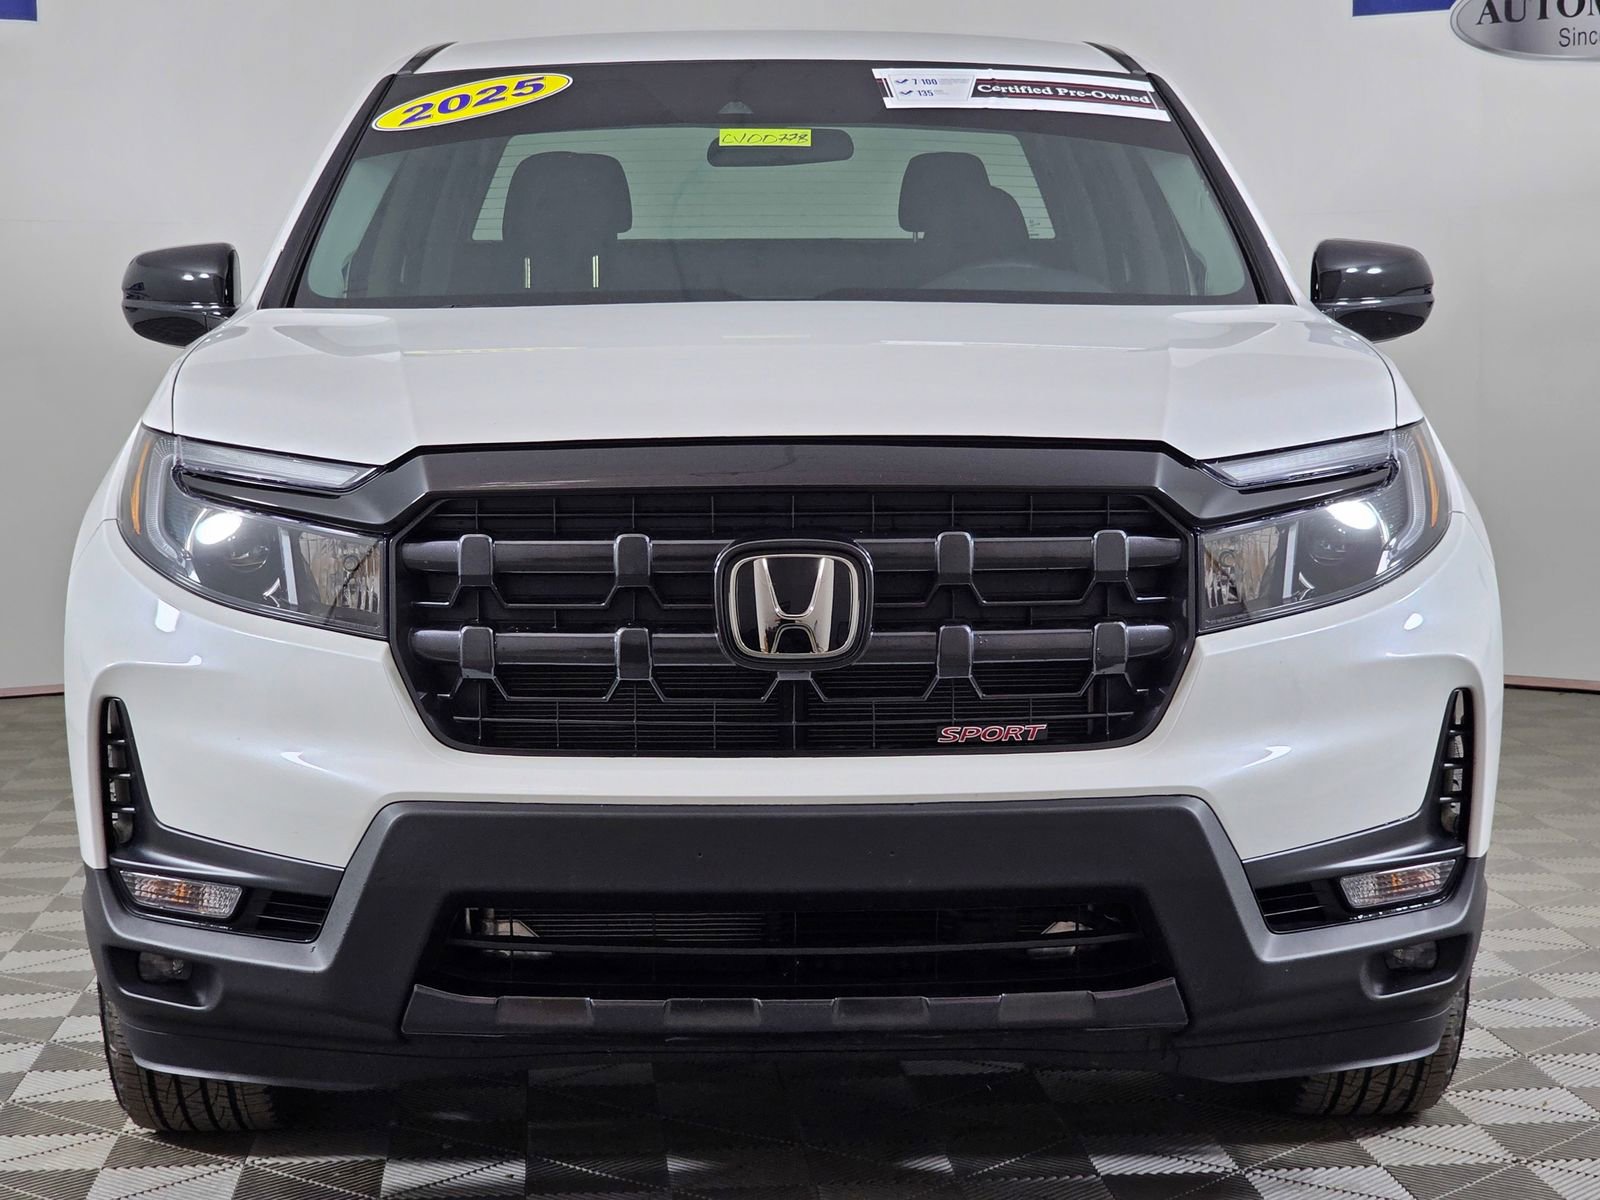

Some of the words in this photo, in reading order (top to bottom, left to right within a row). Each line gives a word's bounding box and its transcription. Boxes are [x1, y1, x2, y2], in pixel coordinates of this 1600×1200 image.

[1559, 27, 1600, 47] Sinc
[399, 76, 546, 127] 2025
[977, 84, 1051, 95] Certified
[1056, 87, 1151, 104] Pre-Owned
[937, 724, 1047, 743] SPORT
